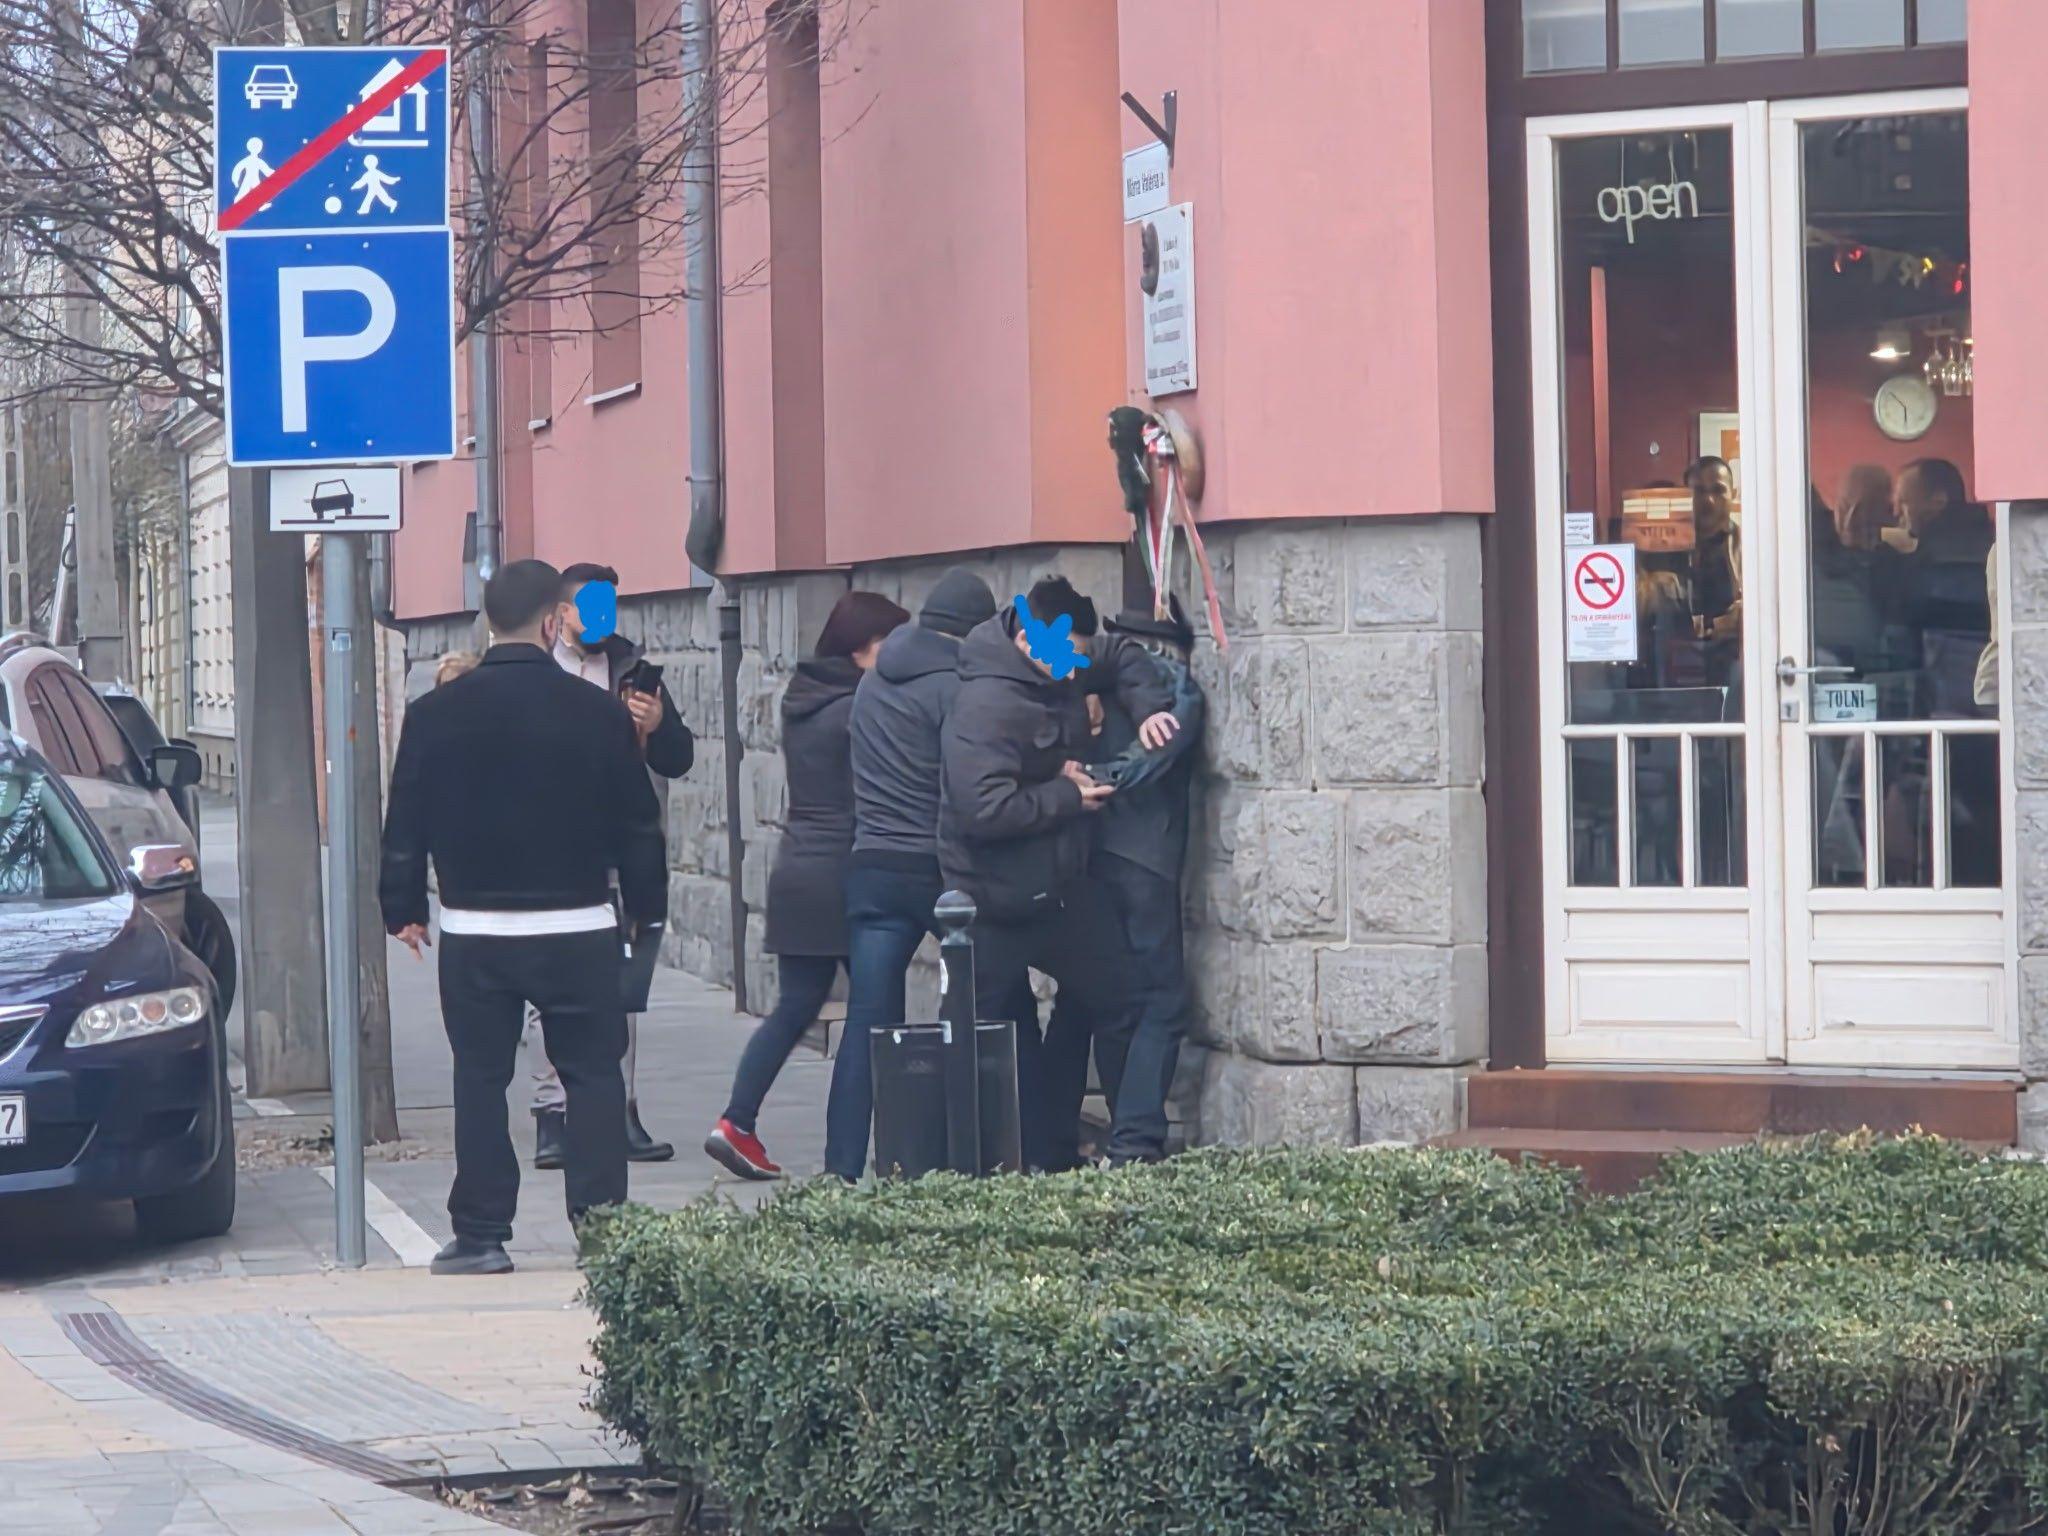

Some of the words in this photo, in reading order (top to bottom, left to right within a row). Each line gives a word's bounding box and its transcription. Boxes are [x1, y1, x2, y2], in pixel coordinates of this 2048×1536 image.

[1597, 180, 1699, 244] open
[278, 265, 397, 434] P
[1825, 690, 1864, 708] TOLNI
[1, 1104, 17, 1134] 7
